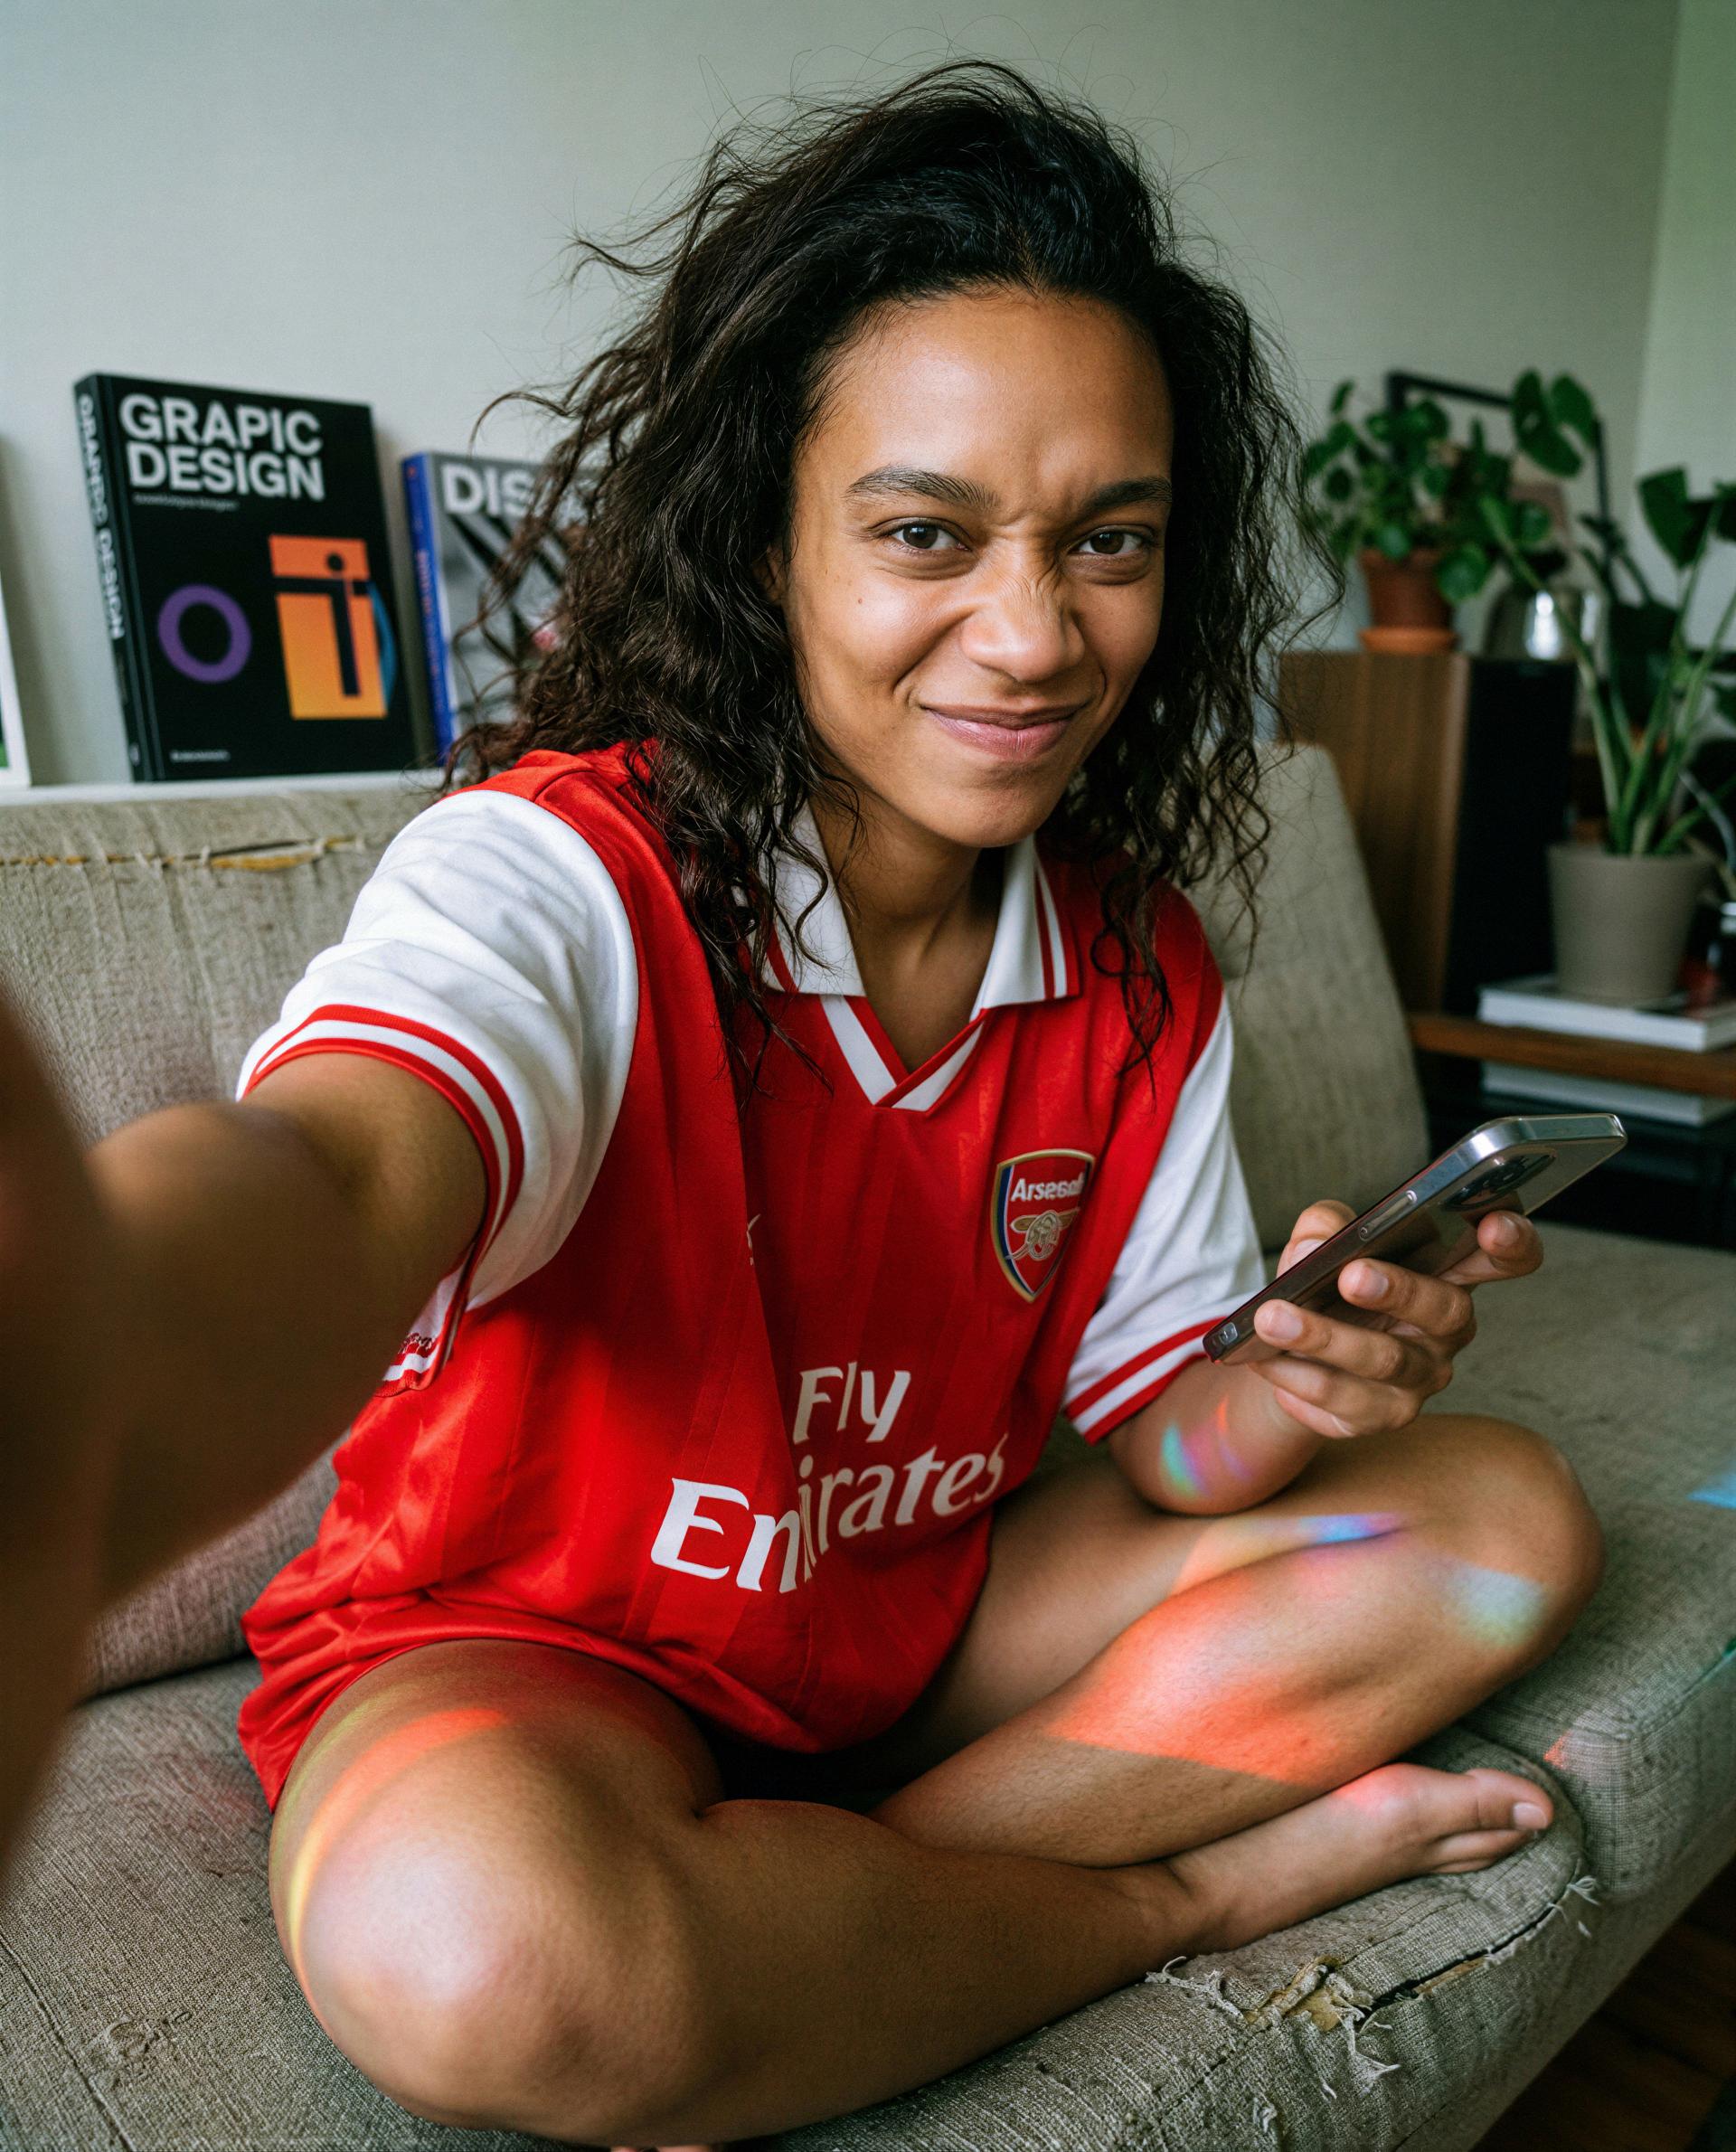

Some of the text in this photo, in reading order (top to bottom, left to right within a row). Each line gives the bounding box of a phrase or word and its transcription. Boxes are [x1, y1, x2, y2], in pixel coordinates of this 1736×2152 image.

[119, 393, 323, 456] GRAPIC
[127, 441, 325, 501] DESIGN
[792, 1362, 910, 1445] Fly
[650, 1433, 1009, 1594] Emirates
